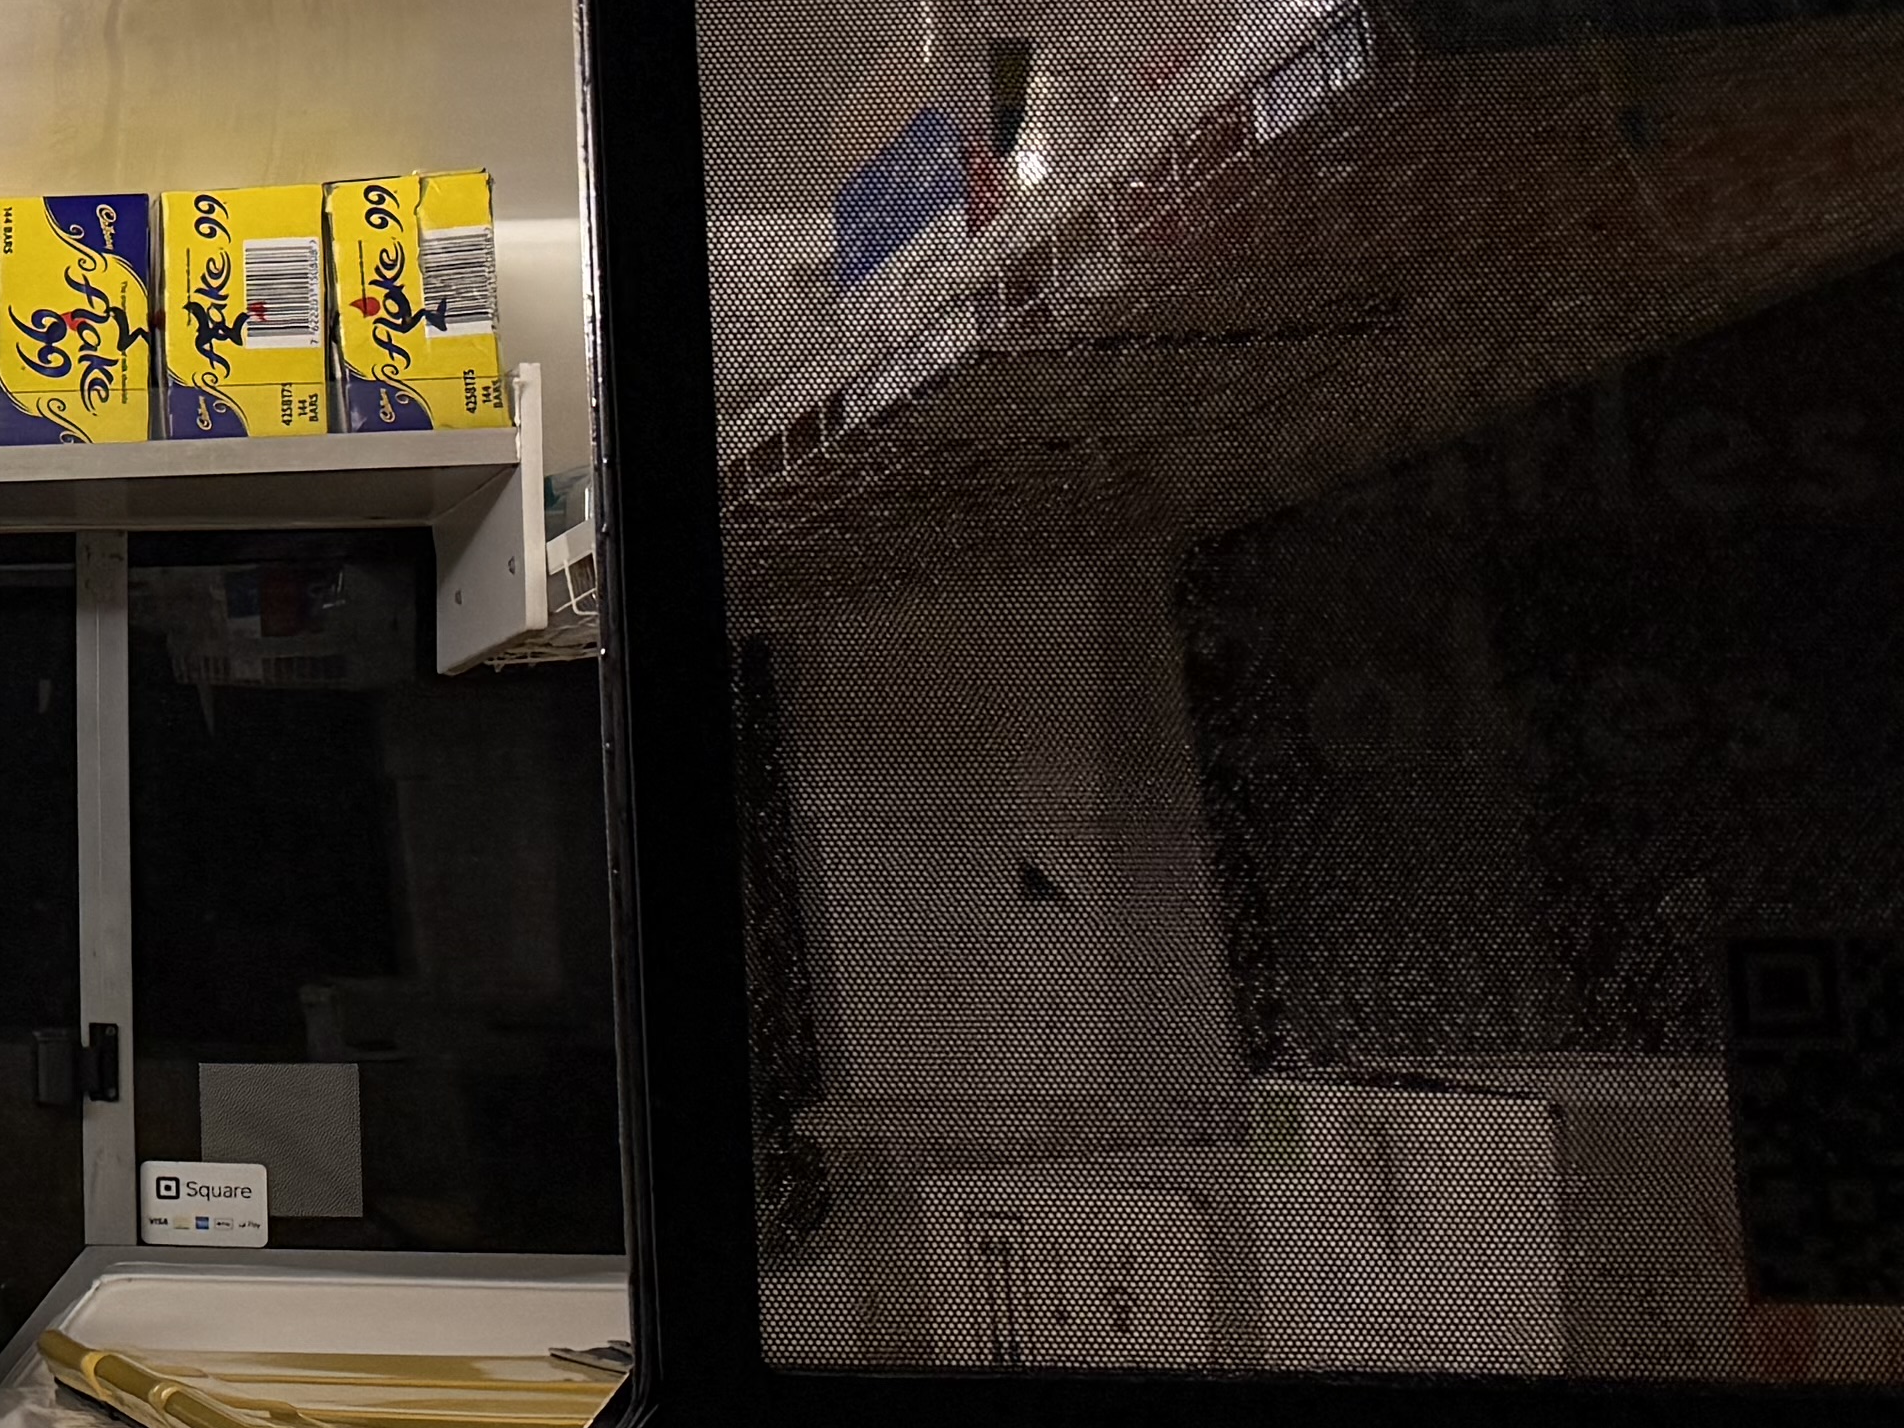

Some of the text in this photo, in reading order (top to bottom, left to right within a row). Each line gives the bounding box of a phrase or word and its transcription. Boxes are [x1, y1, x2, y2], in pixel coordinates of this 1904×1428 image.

[3, 206, 14, 255] 144 BARS
[193, 193, 232, 245] 99
[363, 184, 404, 233] 99
[7, 304, 73, 378] 99
[185, 1181, 253, 1201] Square
